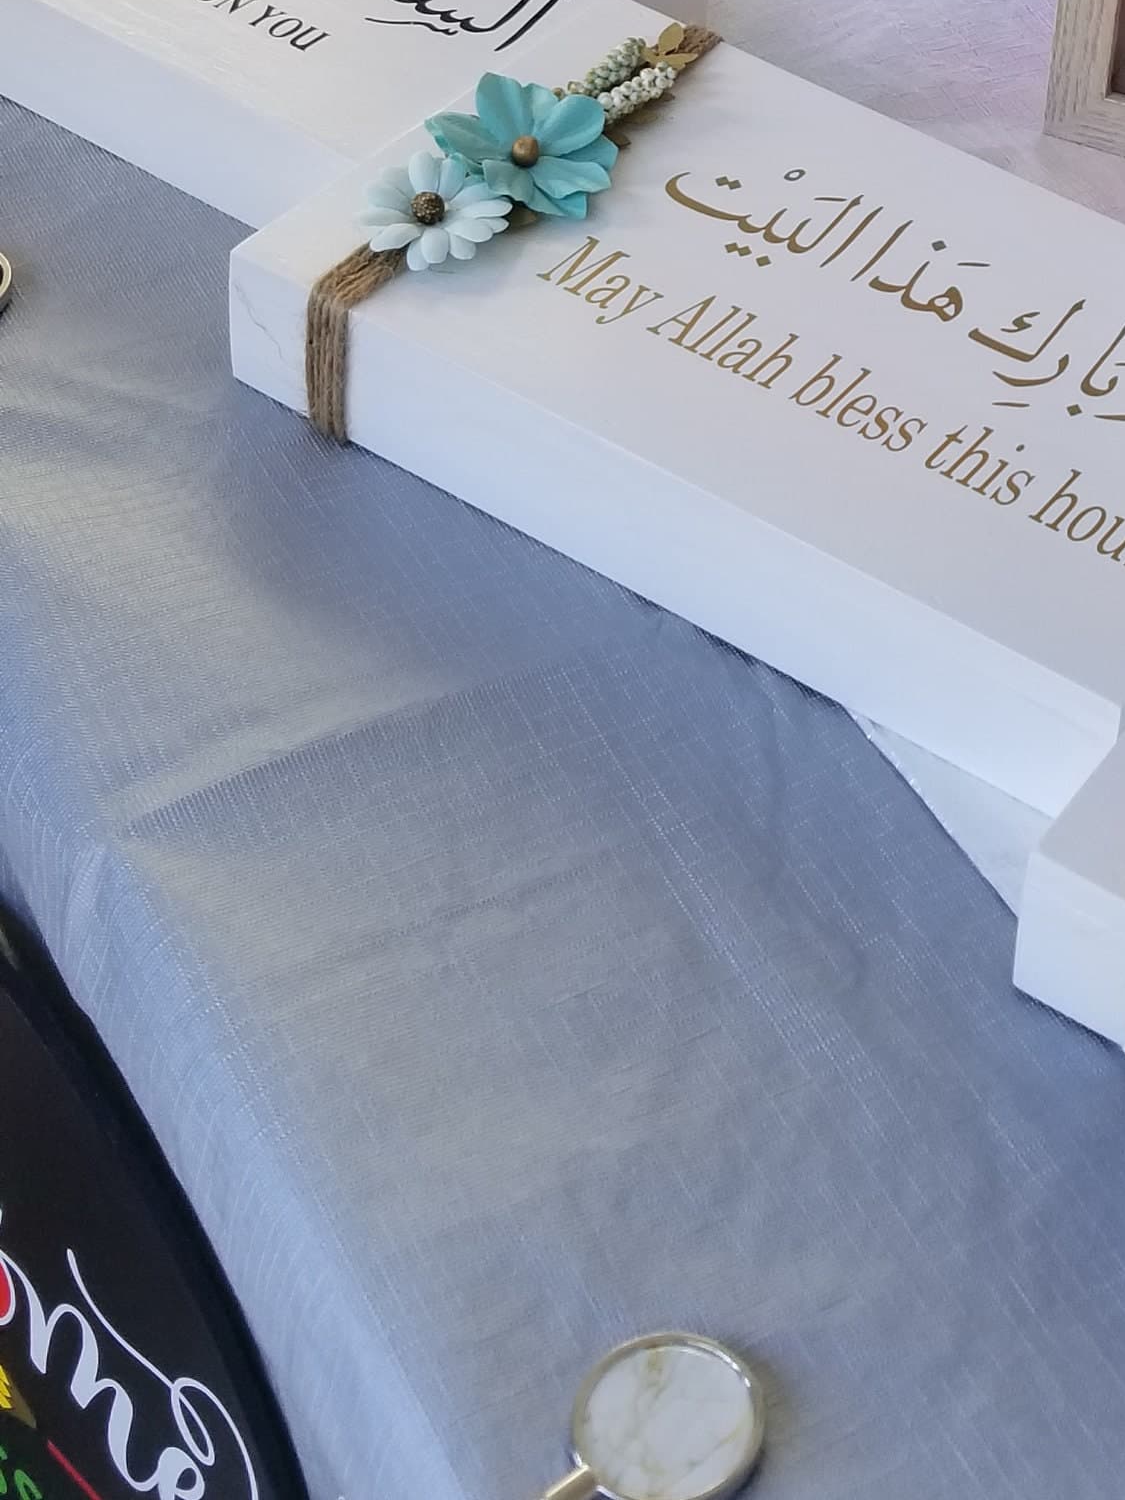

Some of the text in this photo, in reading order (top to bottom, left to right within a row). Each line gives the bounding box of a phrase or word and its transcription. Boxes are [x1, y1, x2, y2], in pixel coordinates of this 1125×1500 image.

[248, 3, 331, 51] YOU
[536, 235, 664, 326] May
[645, 294, 801, 390] Allah
[788, 353, 928, 453] bless
[923, 424, 1036, 506] this
